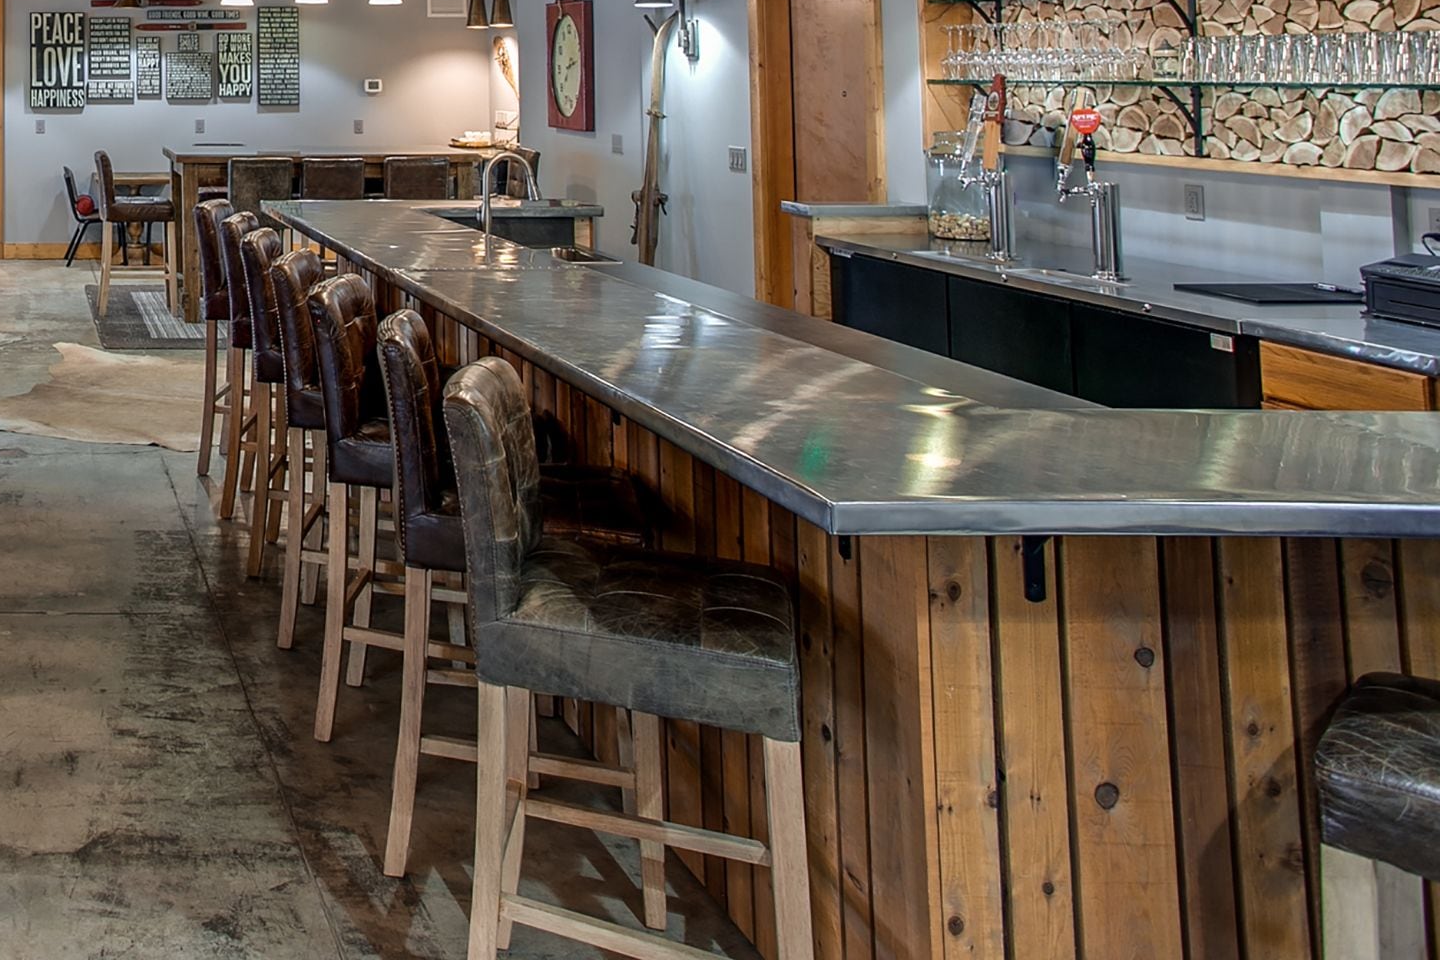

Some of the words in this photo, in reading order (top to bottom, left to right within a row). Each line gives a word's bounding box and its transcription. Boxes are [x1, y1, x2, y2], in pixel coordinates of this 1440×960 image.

[31, 13, 84, 44] PEACE
[219, 34, 229, 43] DO
[230, 34, 251, 43] MORE
[219, 43, 228, 52] OF
[230, 43, 251, 52] WHAT
[137, 58, 159, 68] HAPPY
[219, 52, 252, 64] MAKES
[31, 46, 84, 87] LOVE
[219, 64, 251, 83] YOU
[219, 83, 252, 97] HAPPY
[31, 89, 84, 108] HAPPINESS
